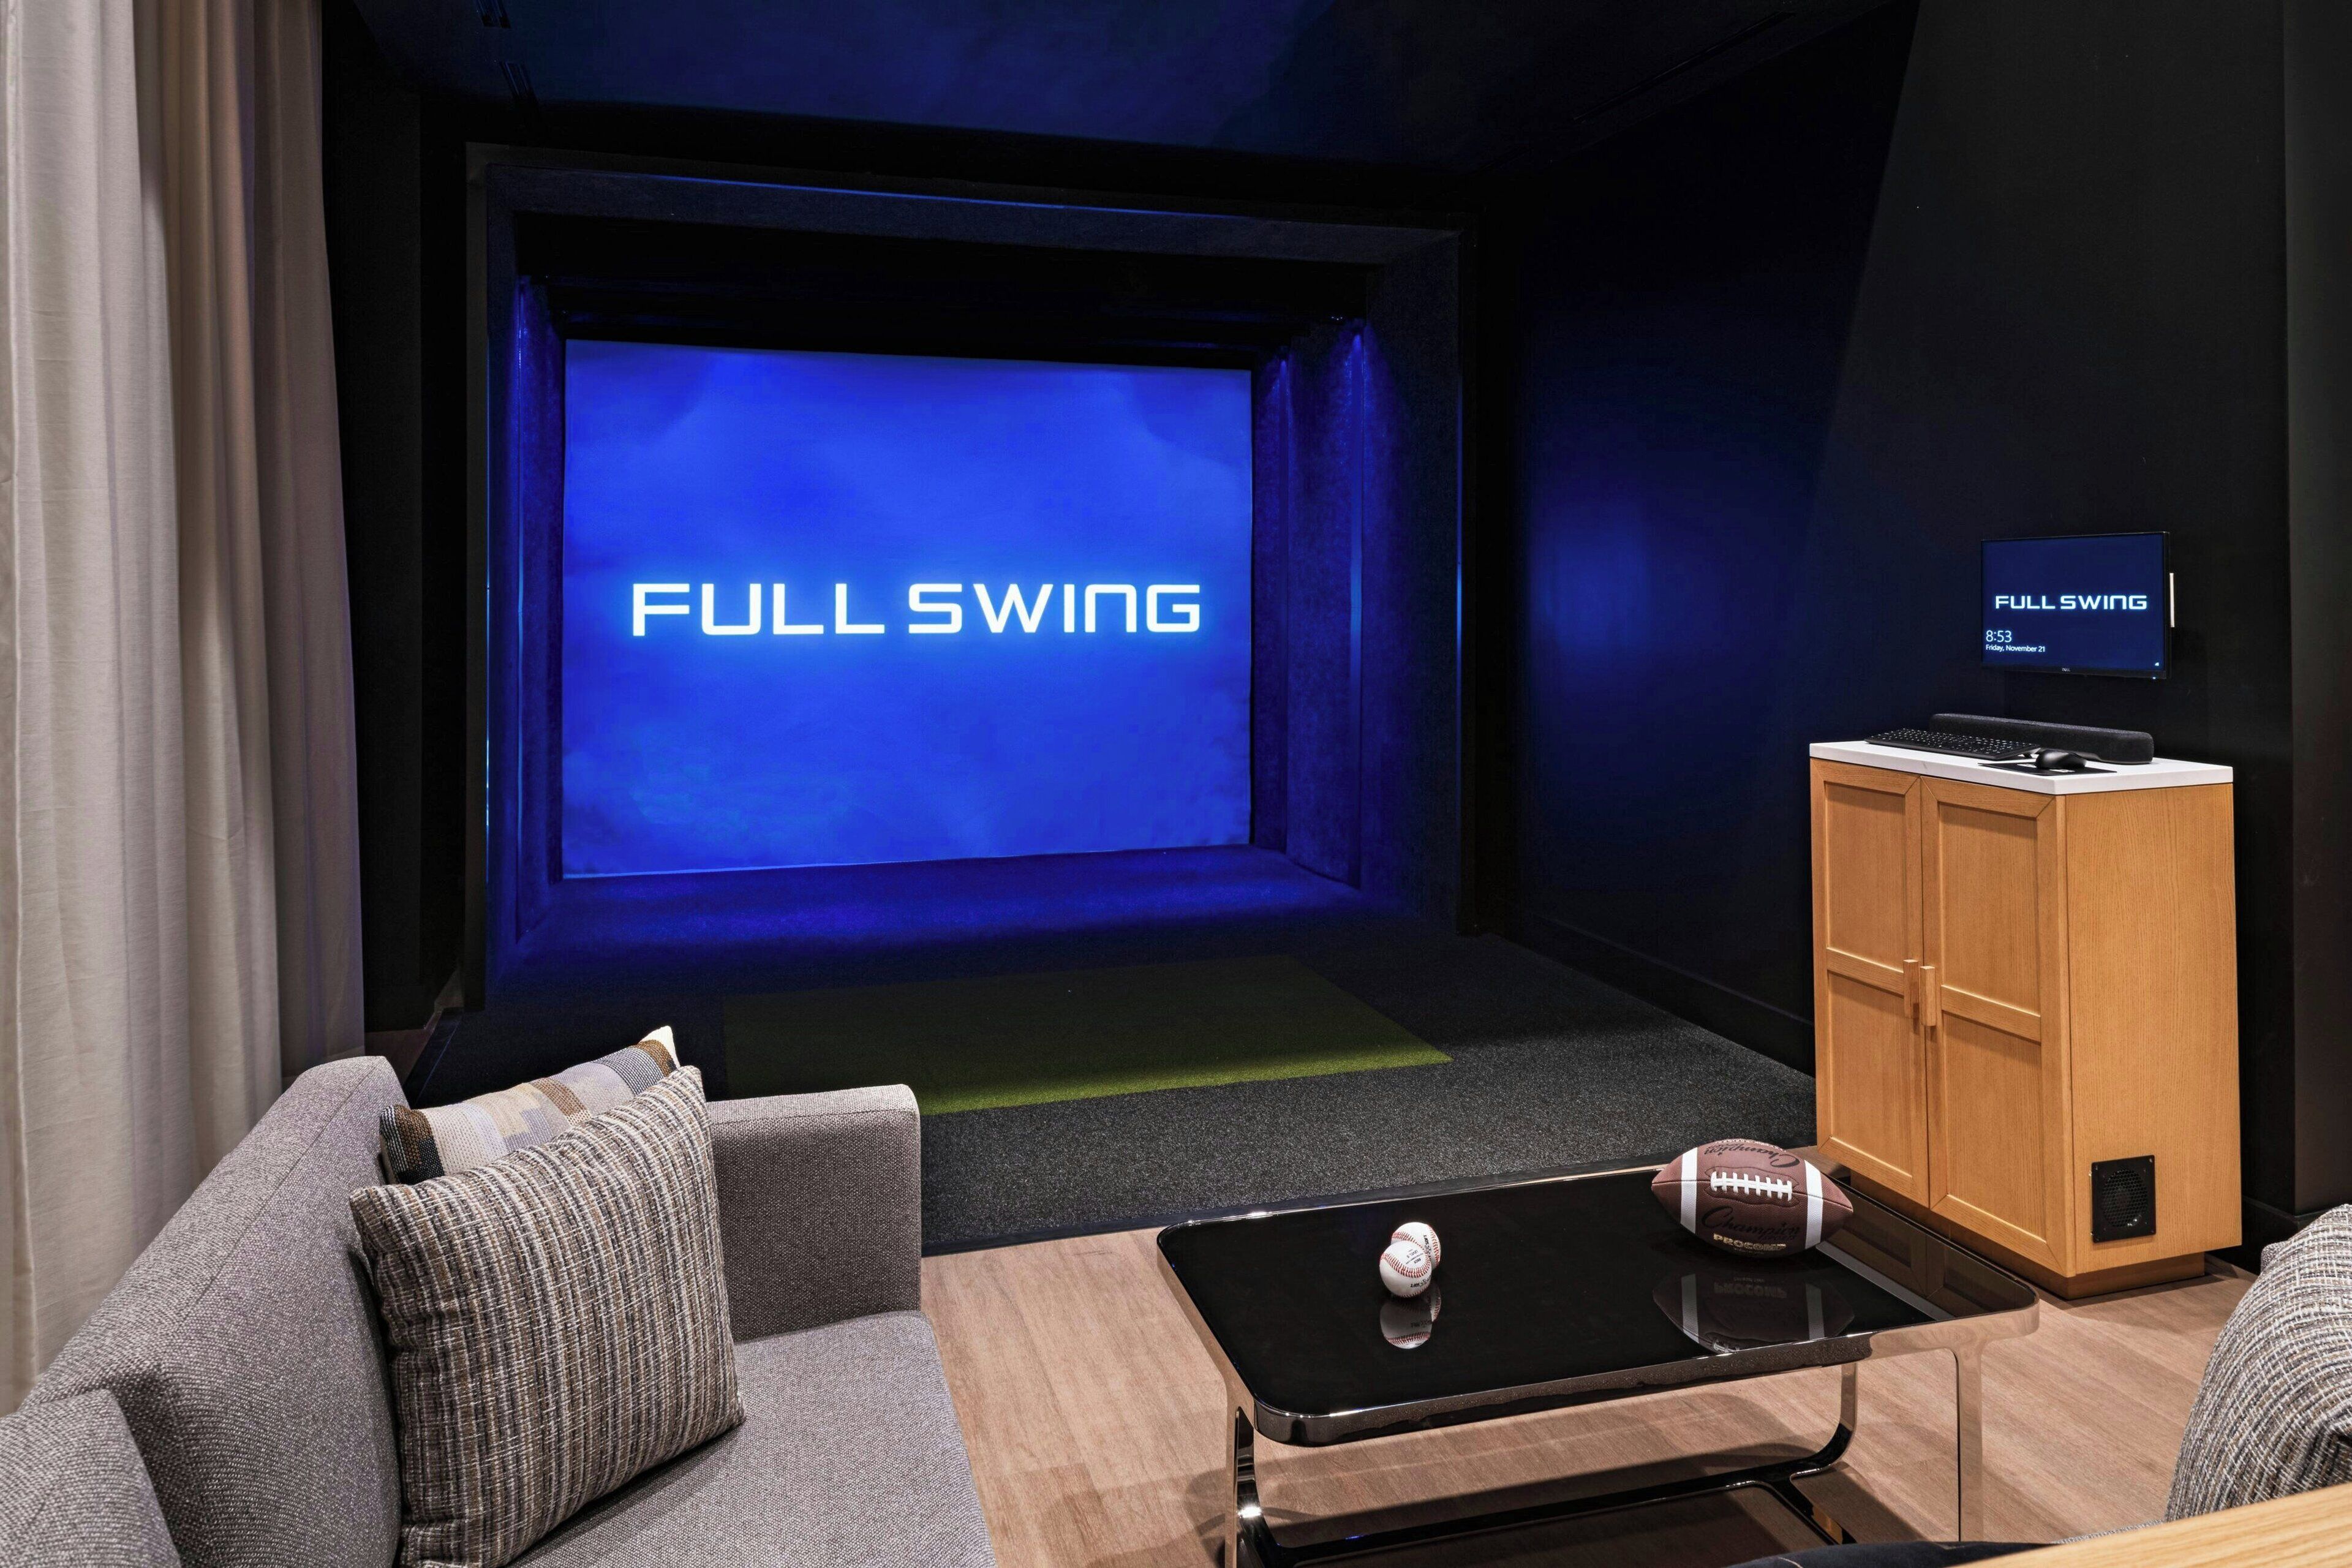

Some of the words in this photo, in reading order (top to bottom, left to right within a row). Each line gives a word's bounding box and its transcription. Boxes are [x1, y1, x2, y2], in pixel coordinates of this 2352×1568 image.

[632, 582, 886, 636] FULL
[908, 583, 1200, 634] SWING
[1995, 595, 2056, 609] FULL
[2060, 595, 2147, 610] SWING
[1985, 630, 2012, 643] 8:53
[1985, 644, 2005, 652] Friday,
[1703, 1143, 1801, 1168] Champion
[1701, 1205, 1801, 1240] Champion
